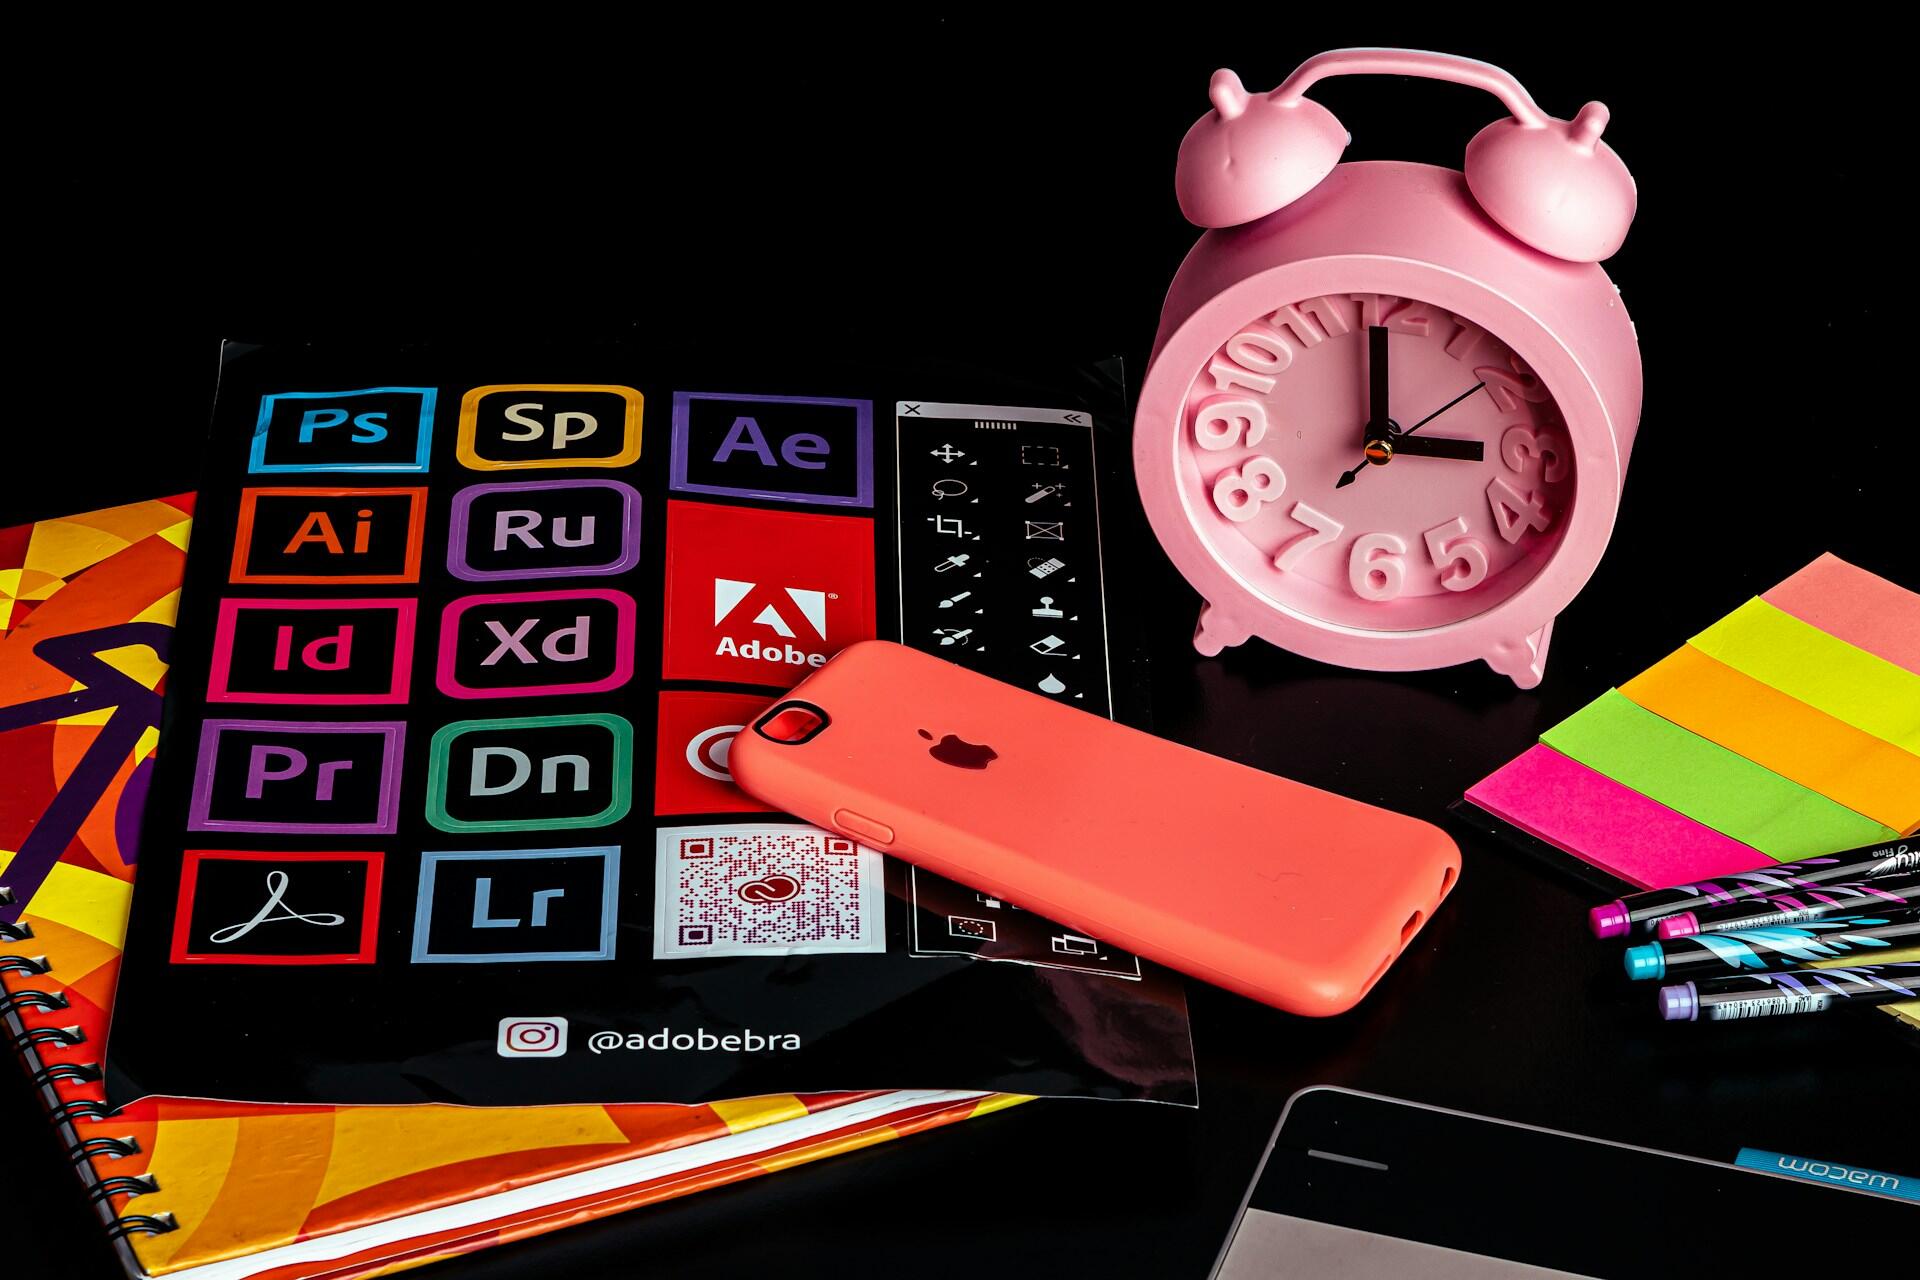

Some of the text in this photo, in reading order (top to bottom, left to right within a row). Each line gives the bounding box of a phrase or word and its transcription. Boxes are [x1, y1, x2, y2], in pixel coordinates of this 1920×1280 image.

[1272, 295, 1350, 348] 11
[1208, 326, 1293, 395] 10
[1473, 352, 1546, 415] 2
[298, 408, 389, 444] Ps
[501, 403, 598, 450] Sp
[712, 416, 831, 470] Ae
[1194, 394, 1267, 452] 9
[1500, 425, 1569, 485] 3
[1213, 456, 1287, 522] 8
[1487, 477, 1551, 545] 4
[283, 509, 374, 554] Ai
[494, 509, 596, 551] Ru
[1274, 501, 1344, 573] 7
[1423, 516, 1489, 592] 5
[1348, 532, 1407, 602] 6
[273, 625, 354, 671] Id
[480, 616, 591, 666] Xd
[715, 636, 827, 668] Adobe
[245, 744, 353, 801] Pr
[469, 746, 590, 796] Dn
[1872, 848, 1895, 858] Fine
[471, 877, 565, 928] Lr
[588, 1028, 801, 1054] @adobebra
[1777, 1156, 1900, 1190] wacom
